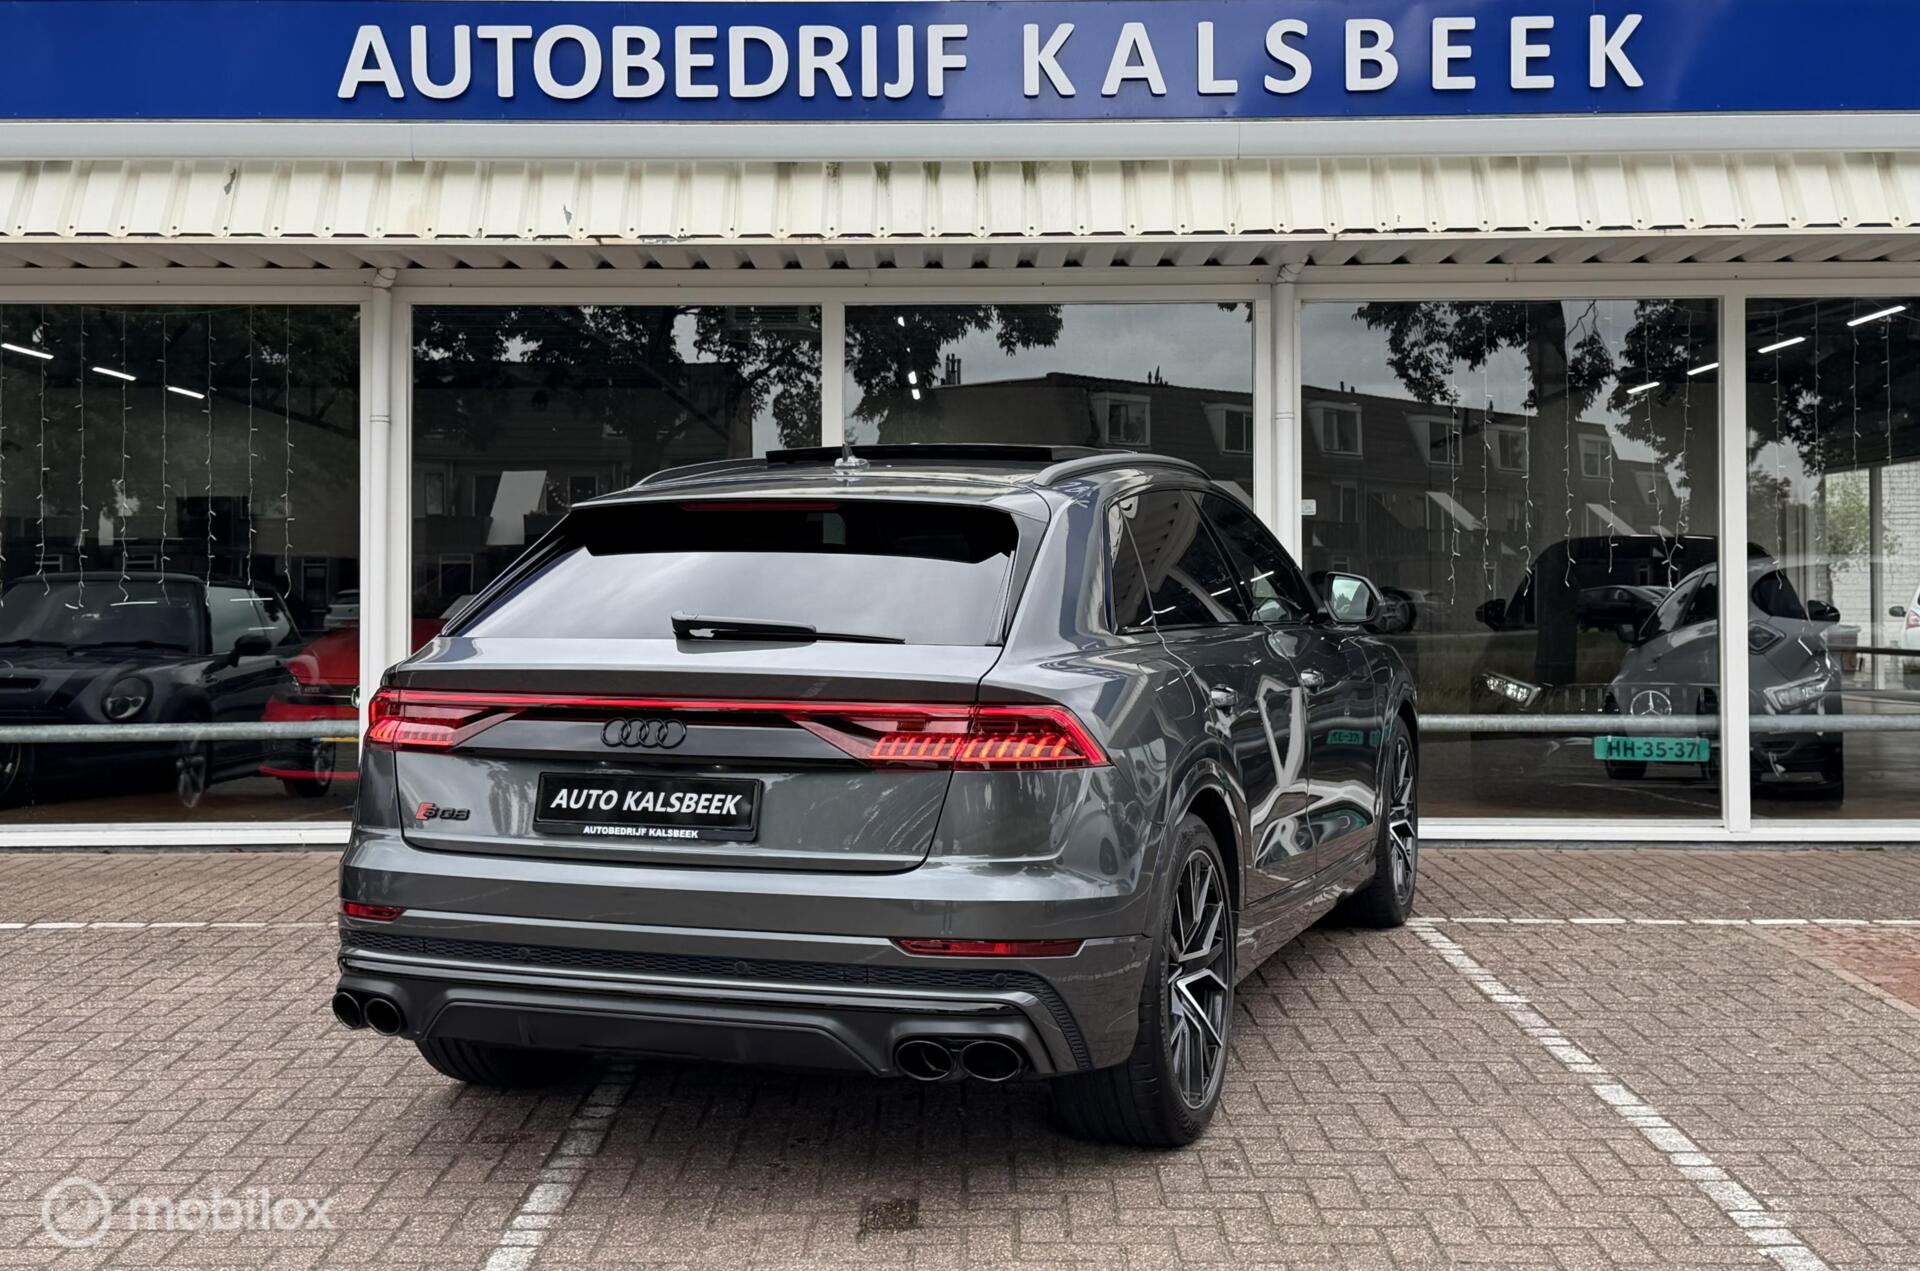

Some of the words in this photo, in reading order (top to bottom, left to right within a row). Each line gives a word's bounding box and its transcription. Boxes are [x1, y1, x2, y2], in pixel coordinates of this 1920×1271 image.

[337, 24, 969, 100] AUTOBEDRIJF
[1022, 14, 1644, 97] KALSBEEK
[1607, 741, 1697, 758] HH-35-37
[550, 788, 619, 811] AUTO
[622, 790, 743, 815] KALSBEEK
[583, 825, 647, 837] AUTOBEDRIJF
[648, 827, 699, 839] KALSBEEK
